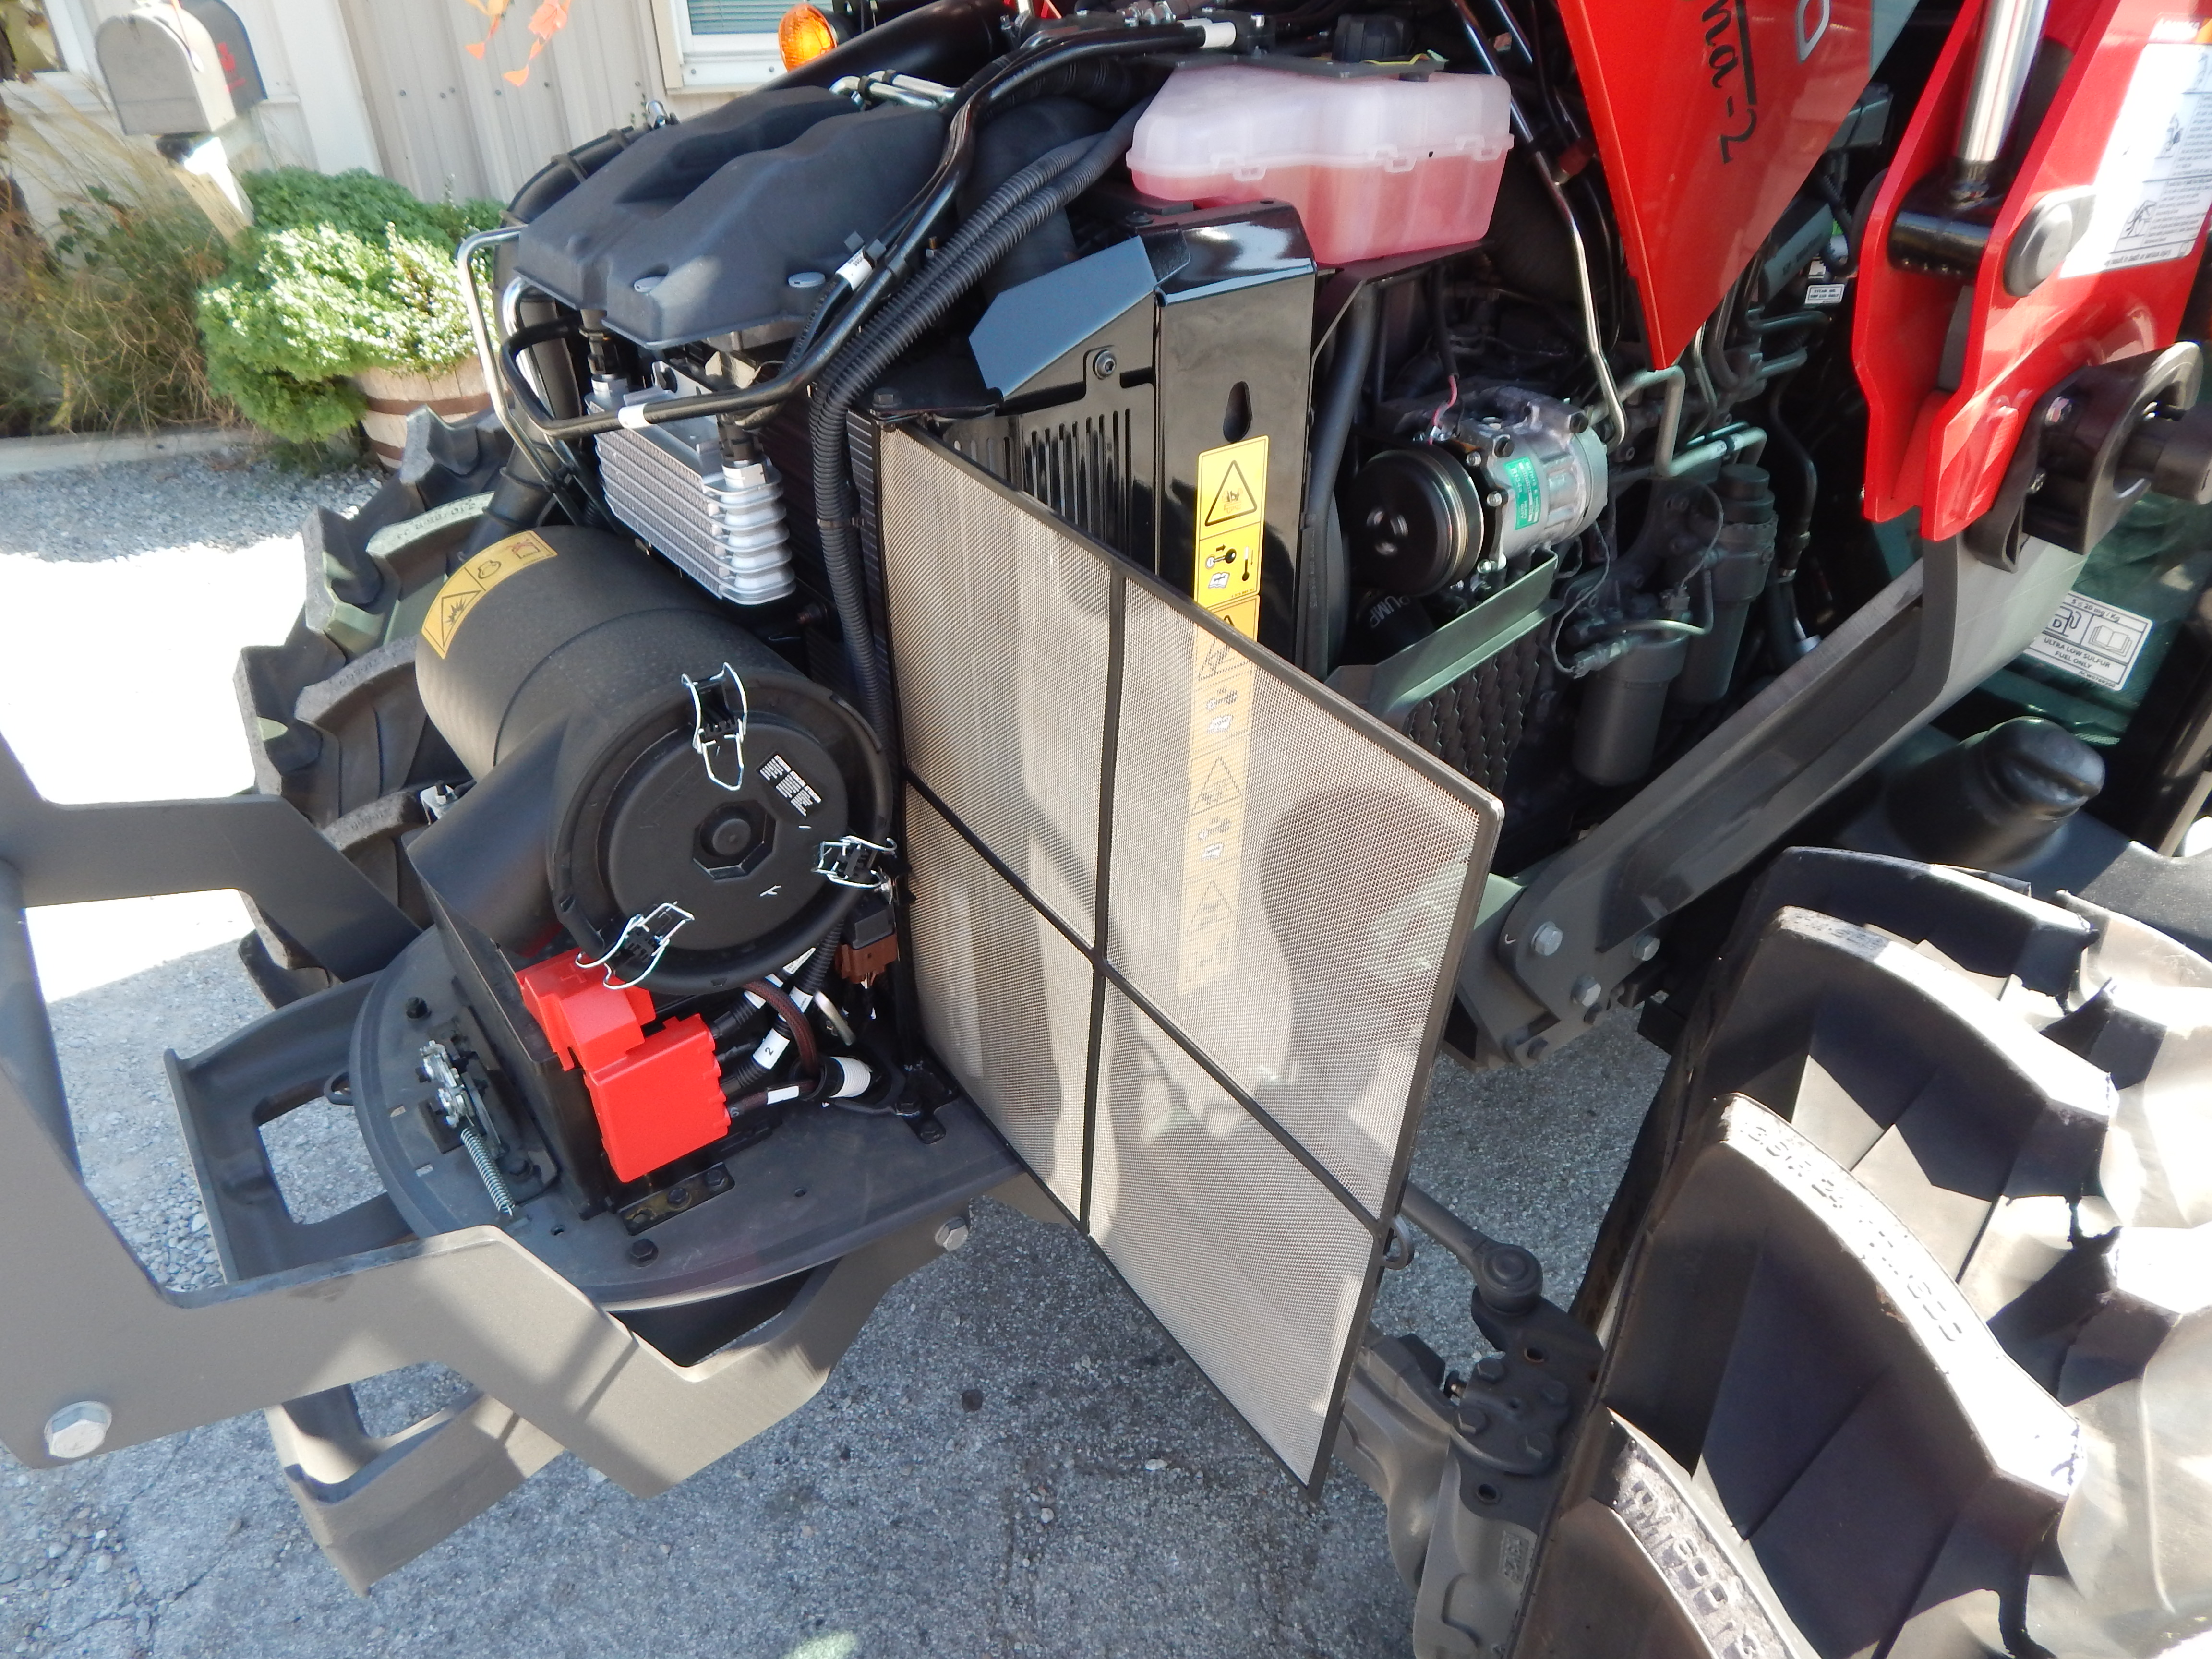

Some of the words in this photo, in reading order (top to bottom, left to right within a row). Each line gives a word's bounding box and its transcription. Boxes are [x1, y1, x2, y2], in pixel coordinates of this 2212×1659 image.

[1702, 0, 1757, 164] na-2
[2084, 602, 2093, 611] 20
[2052, 618, 2063, 629] D
[2043, 637, 2066, 650] ULTRA
[2066, 646, 2082, 657] LOW
[2082, 652, 2111, 668] SULFUR
[2055, 650, 2072, 661] FUEL
[2072, 658, 2092, 669] ONLY
[765, 1046, 774, 1056] 2
